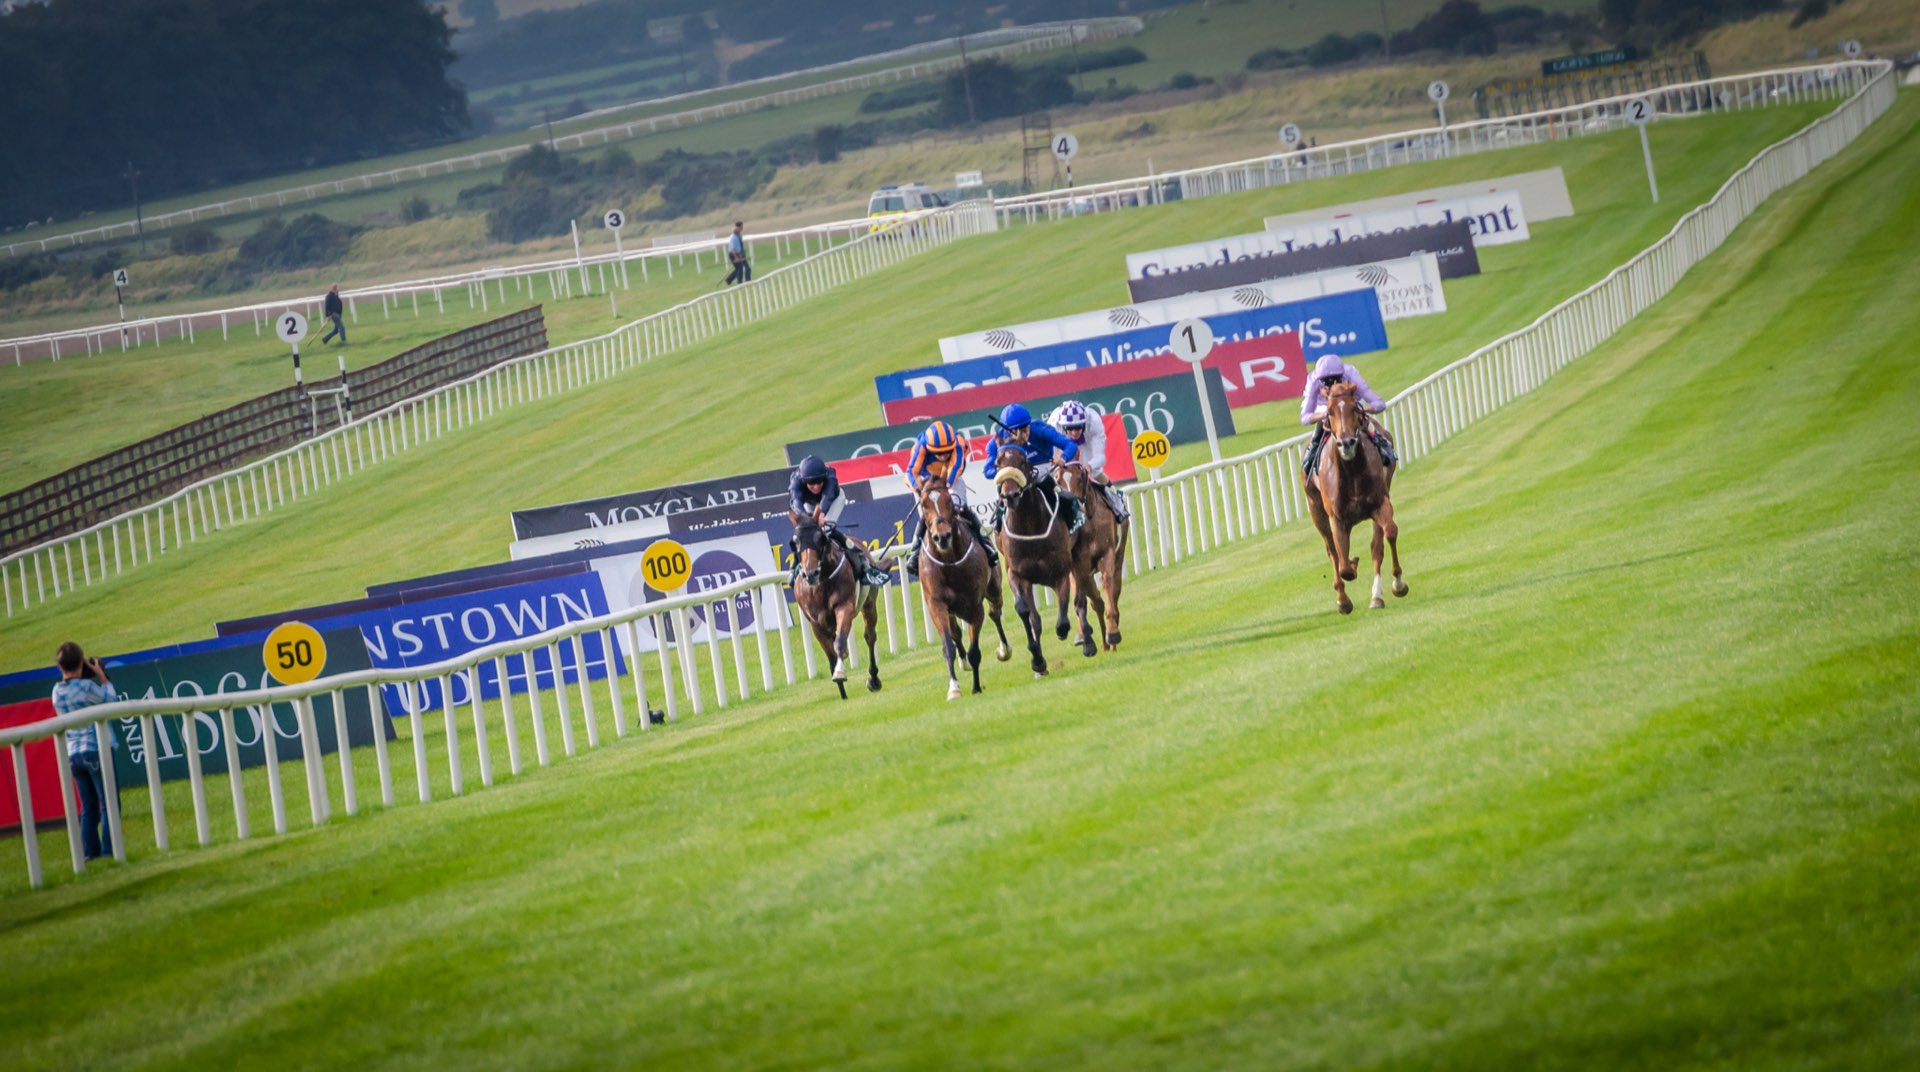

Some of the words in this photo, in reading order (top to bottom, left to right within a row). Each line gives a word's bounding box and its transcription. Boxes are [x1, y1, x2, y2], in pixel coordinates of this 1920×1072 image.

[1435, 84, 1443, 98] 3
[1632, 100, 1646, 120] 2
[1284, 126, 1297, 143] 5
[1057, 136, 1070, 155] 4
[608, 212, 621, 227] 3
[116, 269, 128, 284] 4
[1385, 297, 1434, 315] ESTATE
[285, 316, 298, 336] 2
[1181, 325, 1197, 353] 1
[1134, 438, 1168, 460] 200
[645, 551, 687, 581] 100
[276, 639, 313, 670] 50
